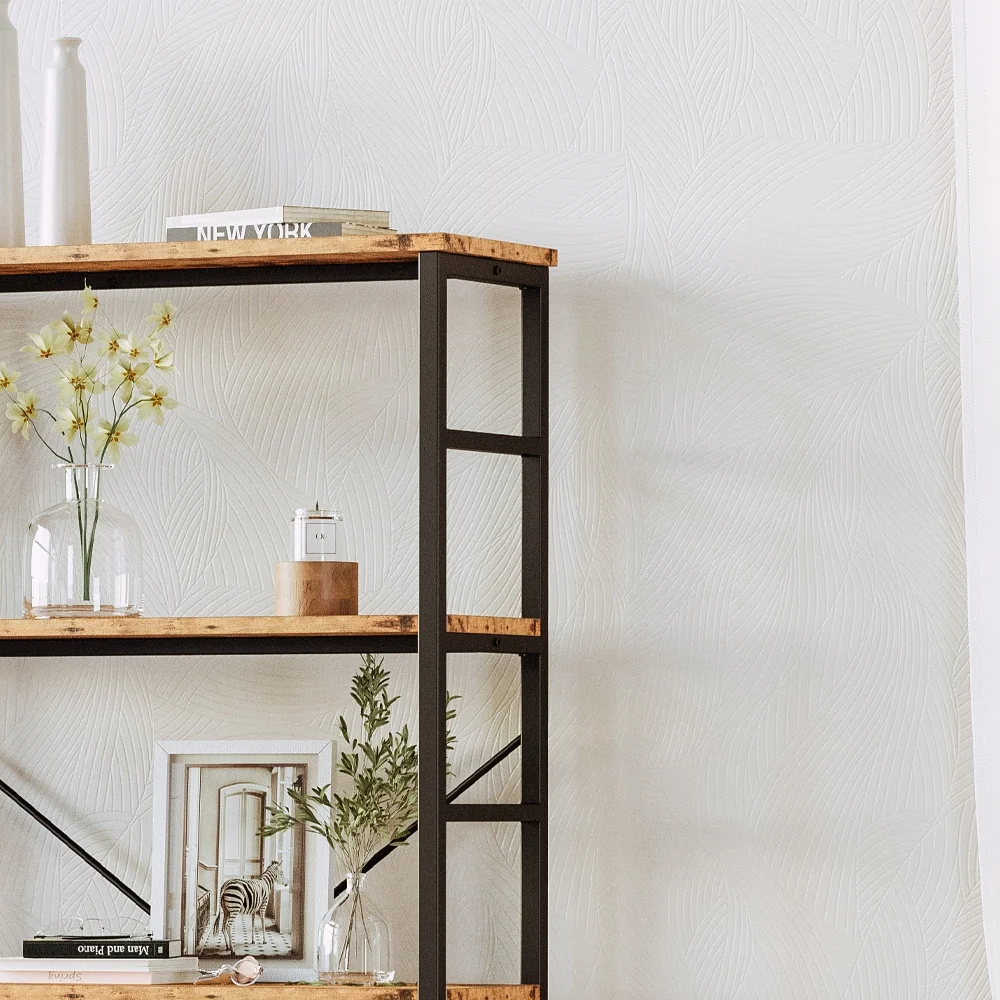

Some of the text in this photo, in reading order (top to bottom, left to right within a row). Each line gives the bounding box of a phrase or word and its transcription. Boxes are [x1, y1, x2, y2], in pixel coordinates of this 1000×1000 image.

[197, 222, 313, 241] NEW YORK
[77, 945, 150, 956] Man and Piano
